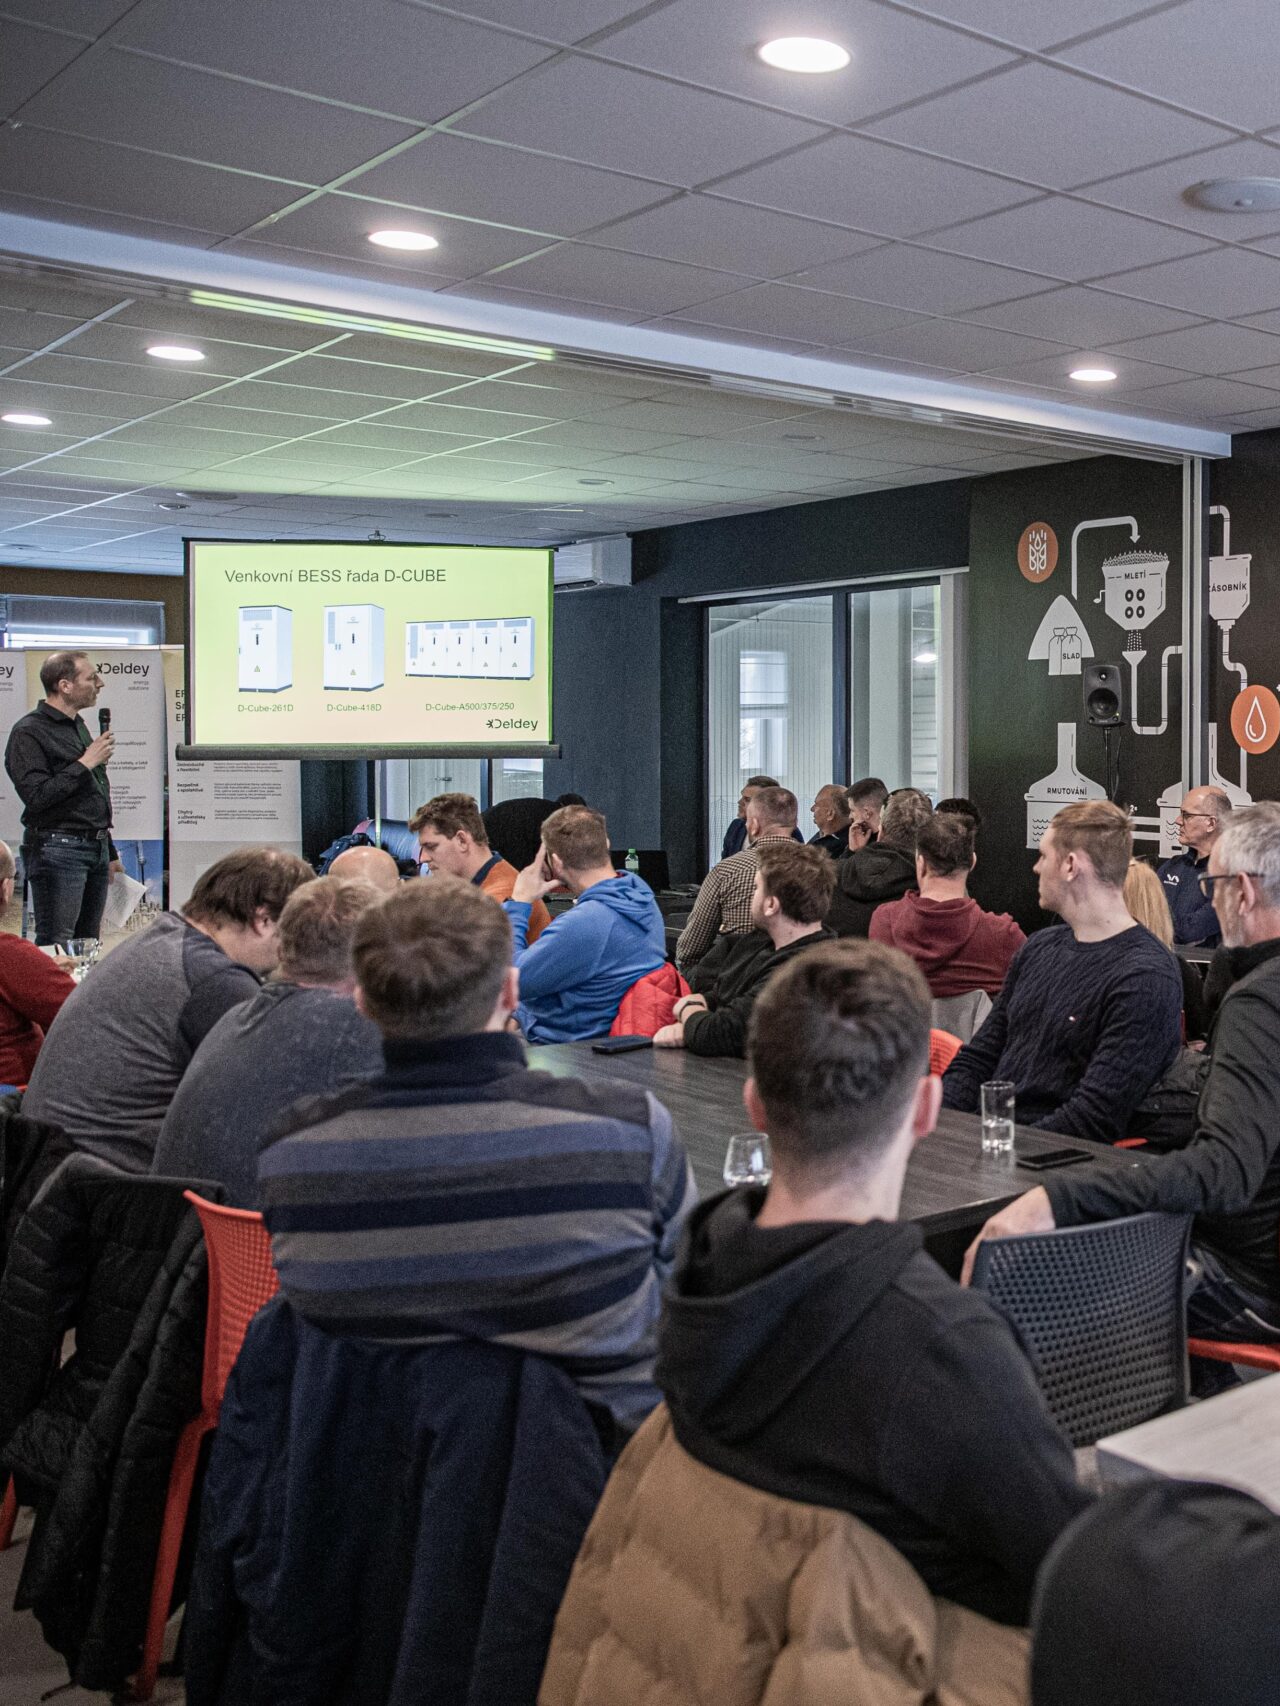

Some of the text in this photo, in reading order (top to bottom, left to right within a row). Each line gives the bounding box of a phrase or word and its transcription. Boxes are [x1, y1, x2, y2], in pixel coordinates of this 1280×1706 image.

[225, 569, 447, 583] Venkovní BESS řada D-CUBE
[1124, 570, 1146, 580] MLETÍ
[237, 702, 515, 713] D-Cube-261D D-Cube-418D D-Cube-A500/375/250
[1046, 786, 1088, 795] RMUTOVÁNÍ
